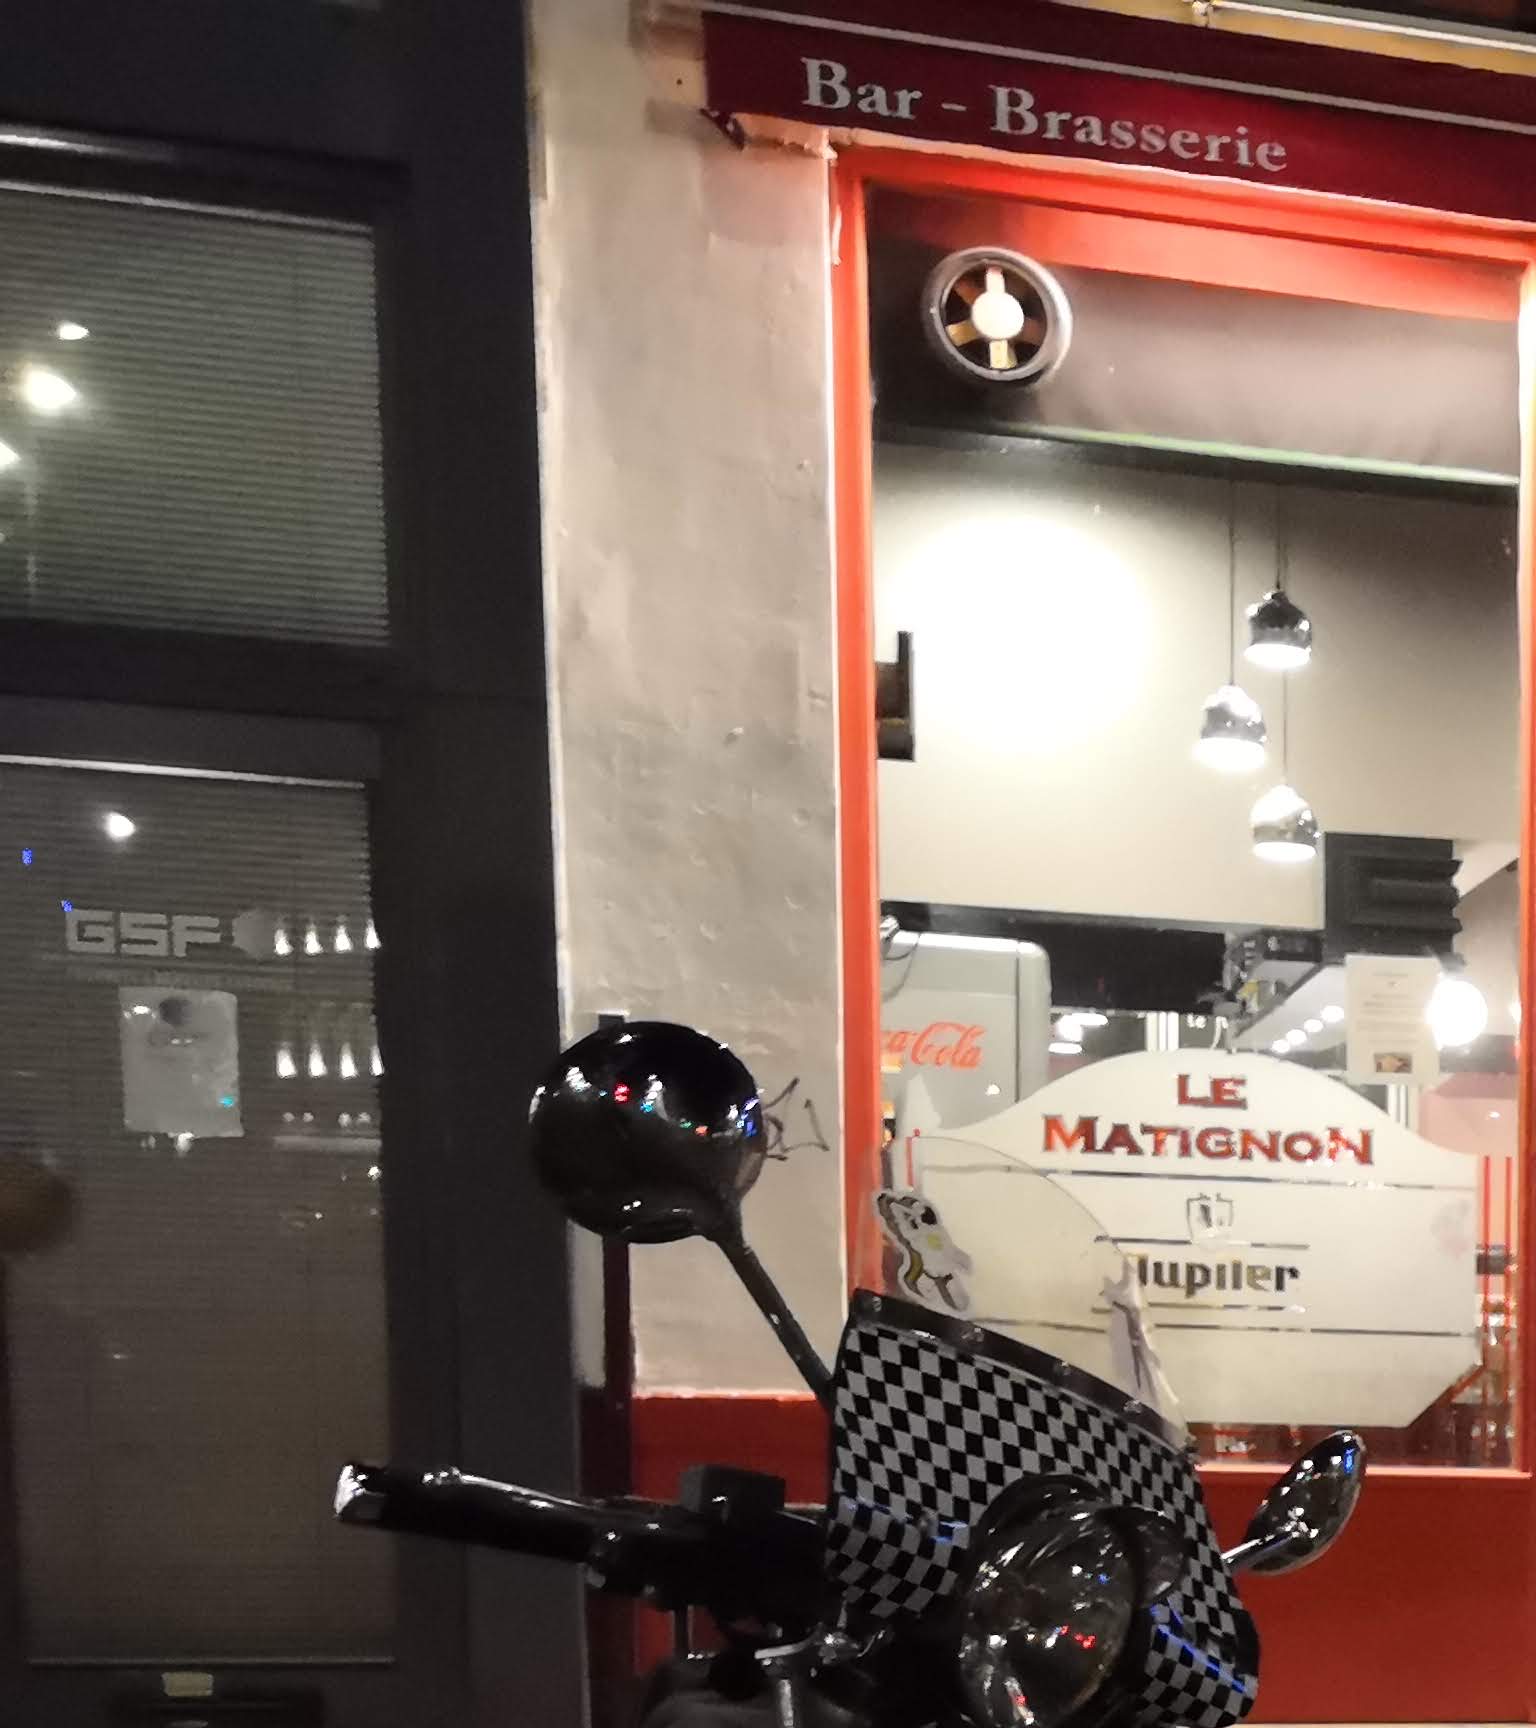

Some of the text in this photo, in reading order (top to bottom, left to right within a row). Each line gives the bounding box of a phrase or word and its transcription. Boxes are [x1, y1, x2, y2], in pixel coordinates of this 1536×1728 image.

[800, 55, 922, 121] Bar
[989, 84, 1288, 174] Brasserie
[66, 908, 222, 958] GSF
[1176, 1073, 1250, 1110] LE
[1042, 1114, 1375, 1166] MATIGNON
